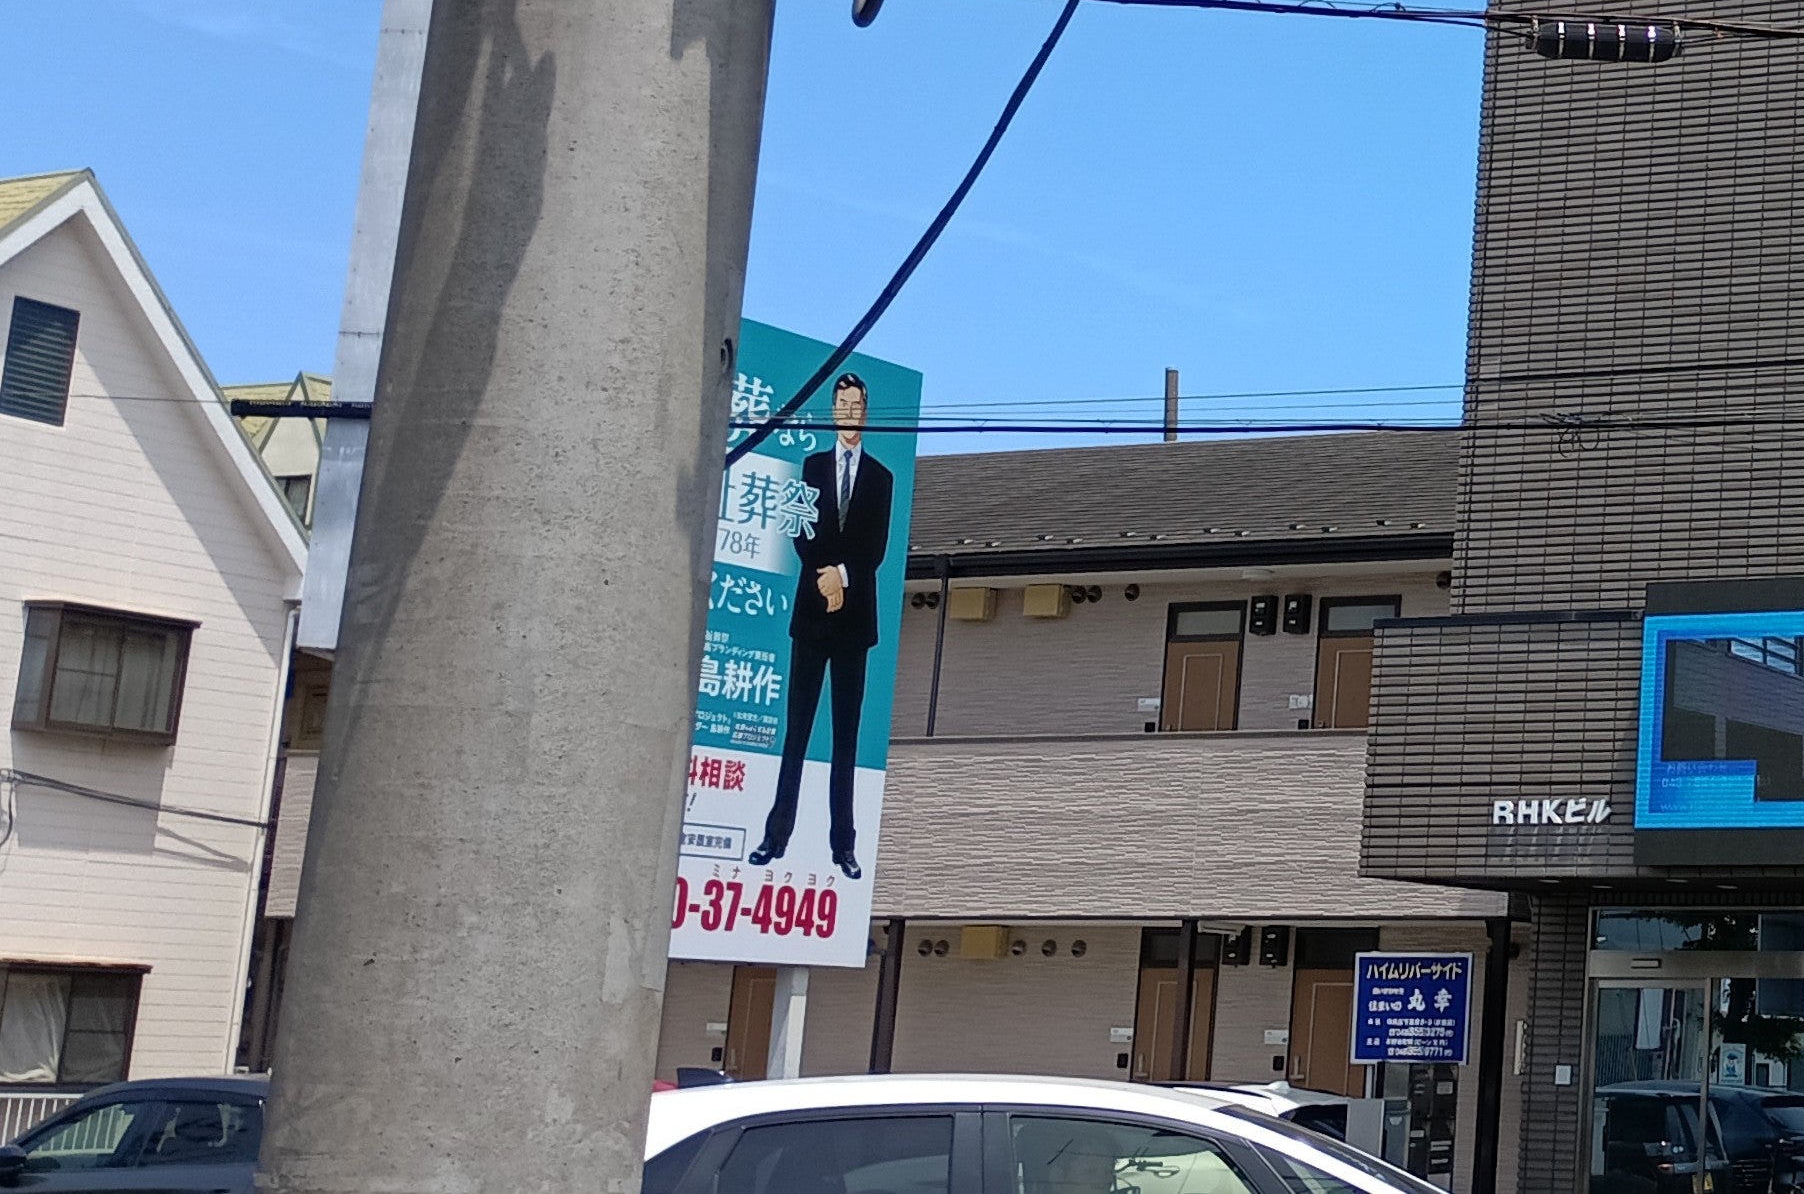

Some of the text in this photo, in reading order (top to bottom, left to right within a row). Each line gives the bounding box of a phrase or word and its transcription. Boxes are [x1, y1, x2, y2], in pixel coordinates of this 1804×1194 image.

[698, 654, 783, 707] 島耕作
[1492, 797, 1612, 825] RHKビル
[1366, 962, 1463, 981] ハイムリバーサイド
